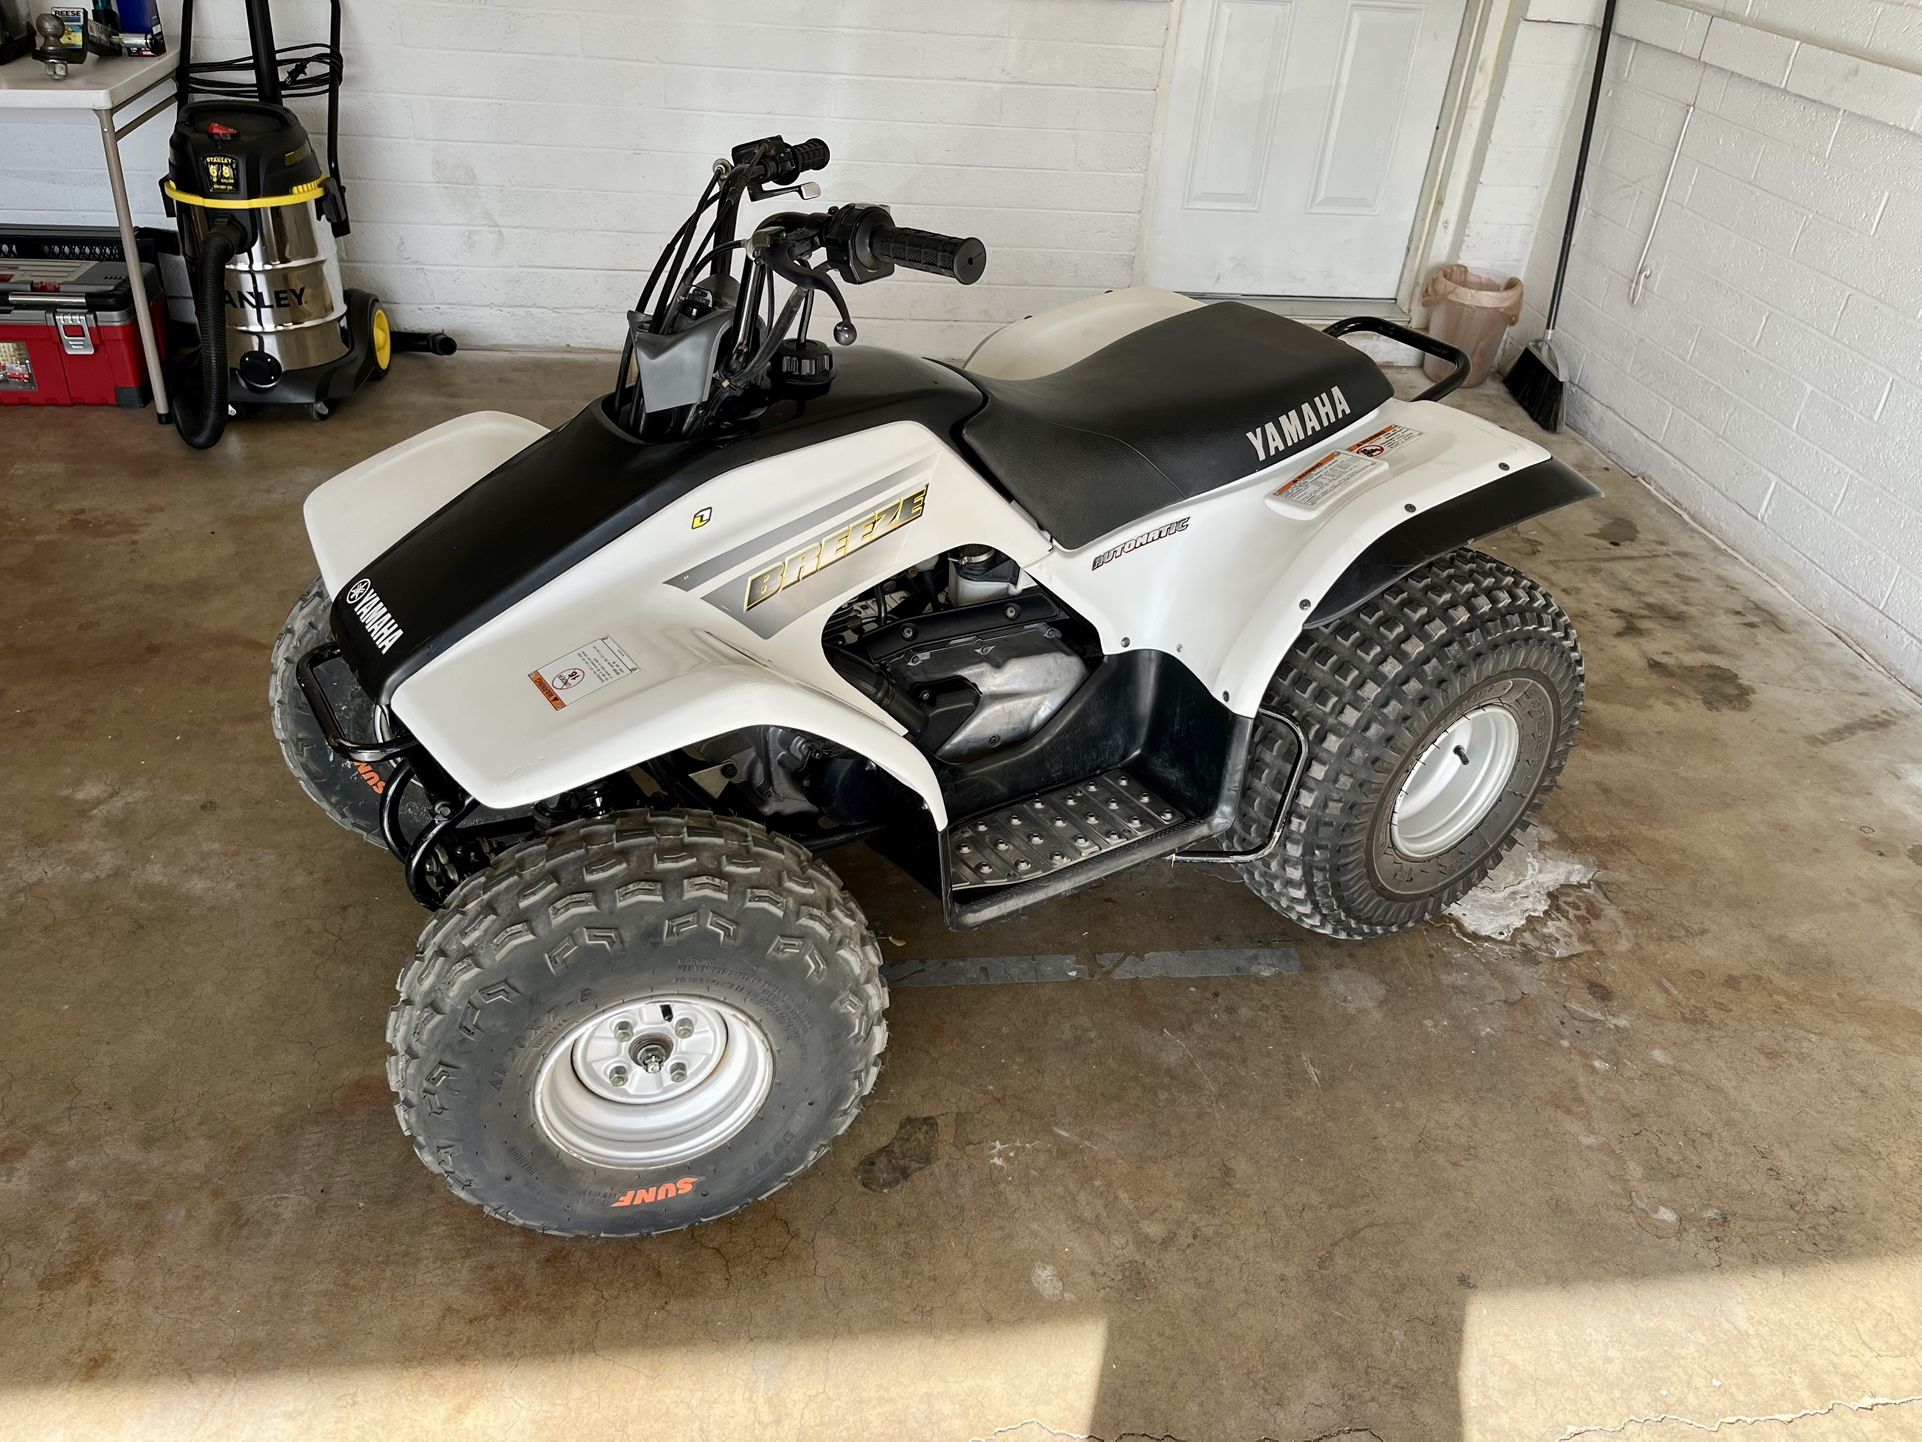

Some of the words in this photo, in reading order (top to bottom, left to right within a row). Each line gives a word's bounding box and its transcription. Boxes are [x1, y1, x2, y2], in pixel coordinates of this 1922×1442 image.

[224, 286, 306, 309] ANLEY
[1246, 385, 1351, 462] YAMAHA
[743, 483, 930, 613] BREEZE
[1092, 516, 1191, 571] AUTOMATIC
[354, 588, 404, 655] YAMAHA
[534, 677, 555, 698] WARNING
[568, 670, 581, 681] 16
[353, 761, 386, 796] SUN
[609, 1176, 702, 1207] SUNF
